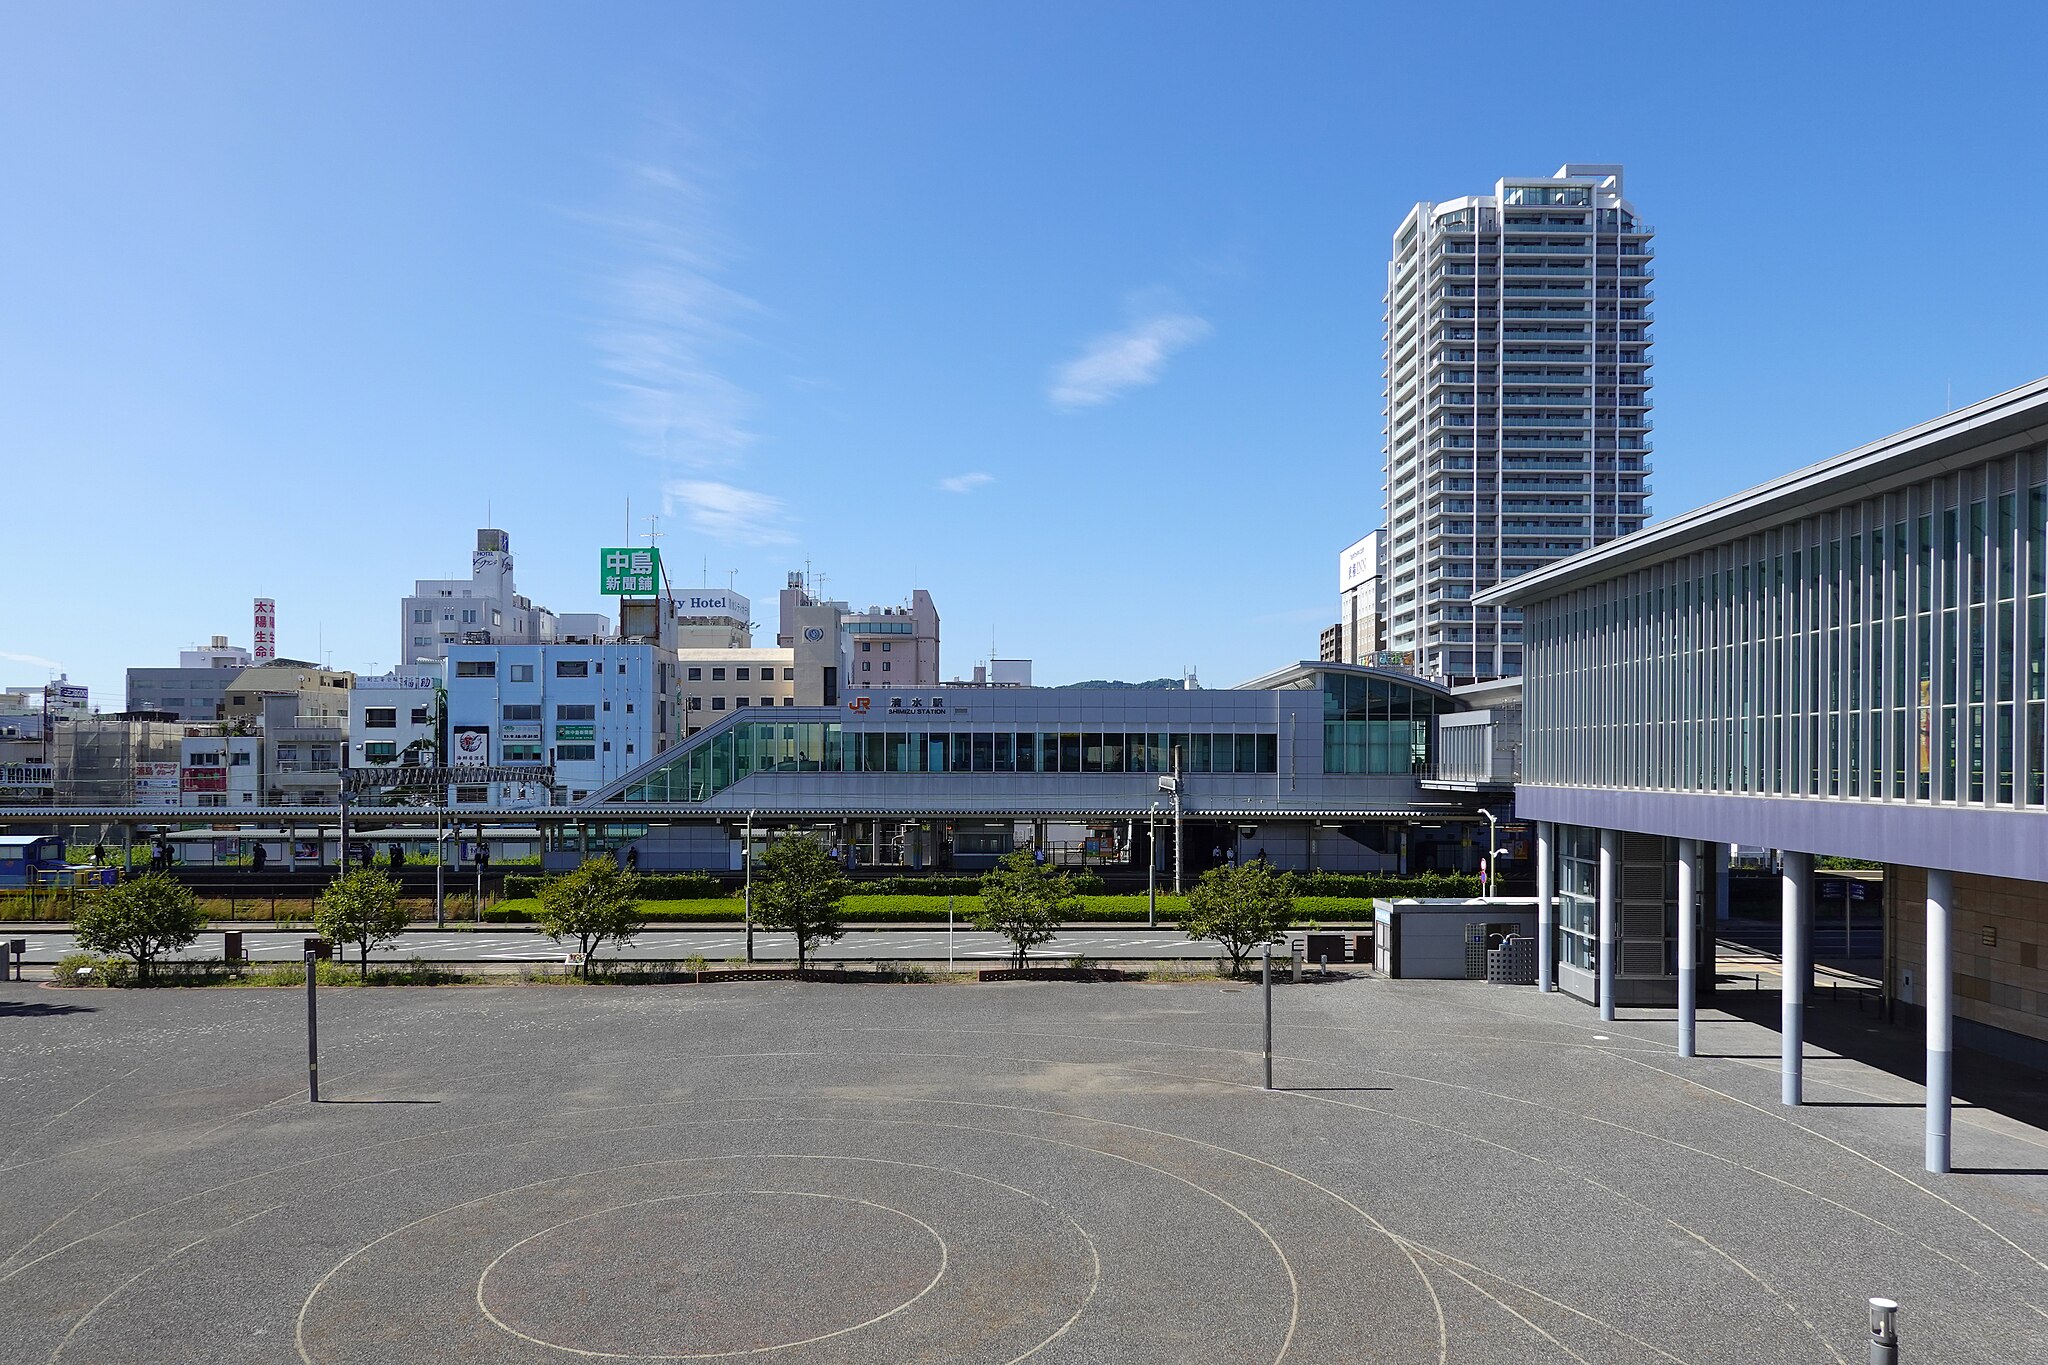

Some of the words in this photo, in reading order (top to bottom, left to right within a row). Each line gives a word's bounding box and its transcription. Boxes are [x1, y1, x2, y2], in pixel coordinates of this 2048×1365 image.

[606, 550, 654, 575] 中島
[606, 576, 653, 591] 新聞舗
[690, 597, 726, 608] Hotel
[255, 601, 268, 658] 太陽生命
[848, 697, 871, 710] JR
[890, 697, 944, 708] 清水駅
[7, 767, 54, 784] HORUM
